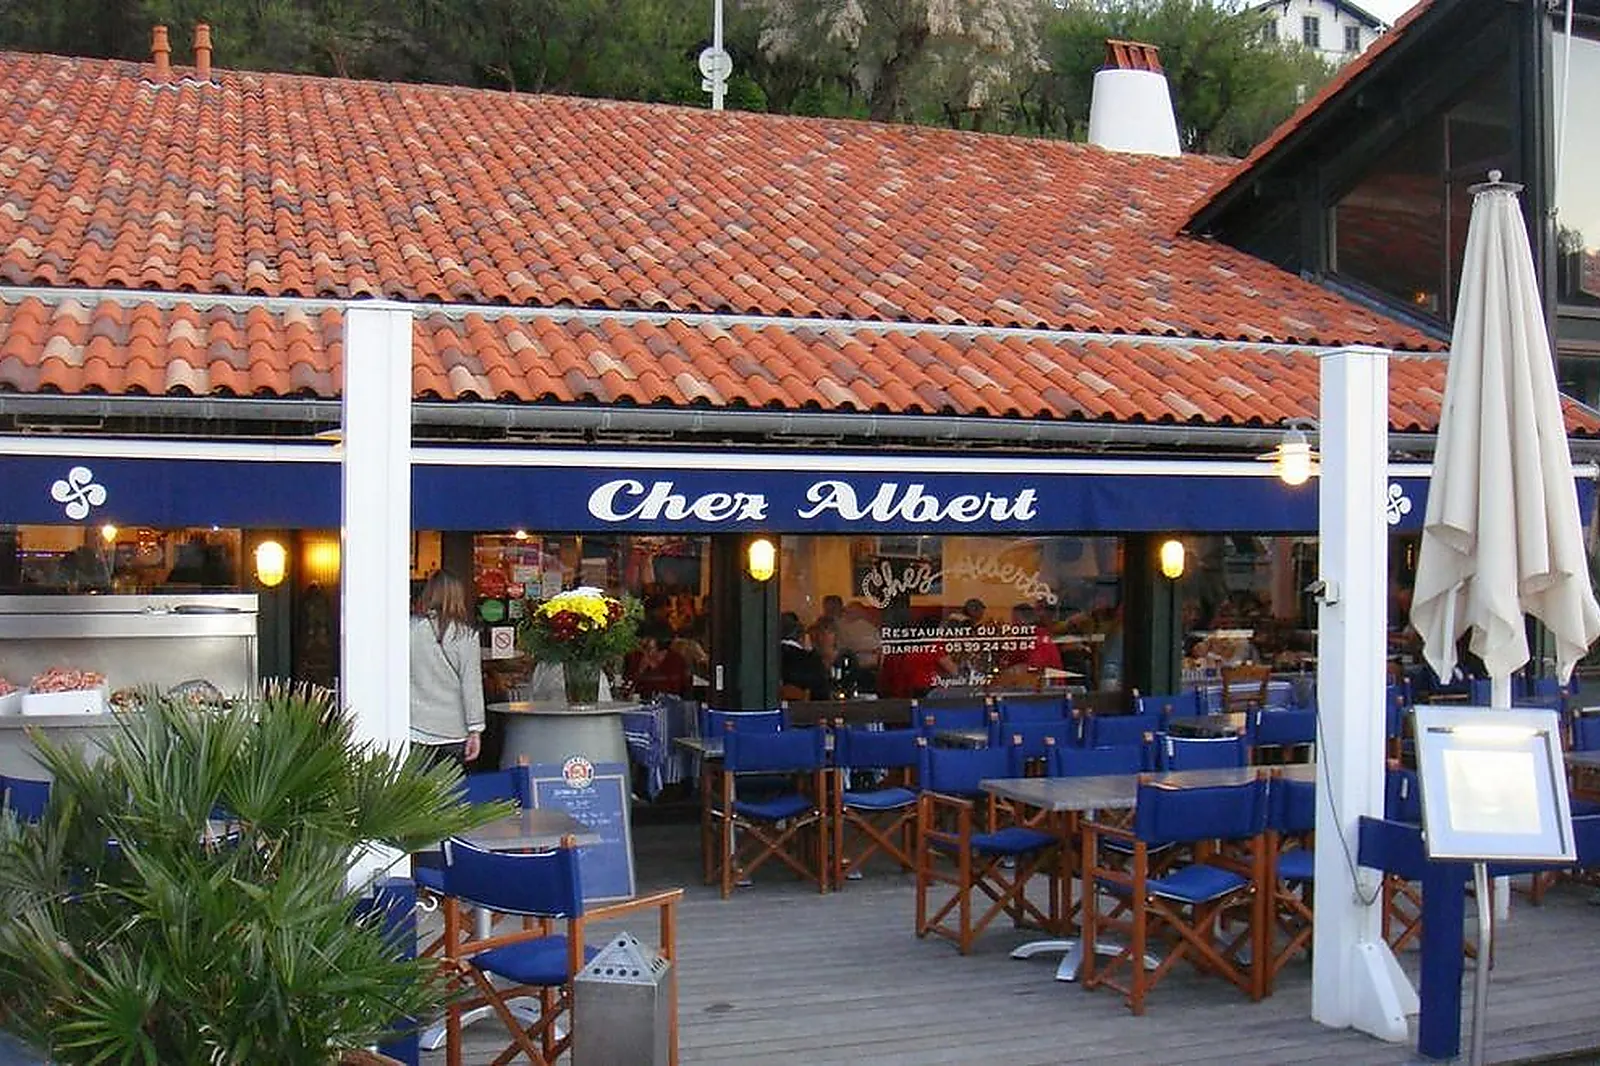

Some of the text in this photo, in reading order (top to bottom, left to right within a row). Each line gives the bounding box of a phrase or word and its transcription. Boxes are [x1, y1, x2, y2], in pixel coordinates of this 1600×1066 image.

[587, 478, 1039, 523] Chez Albert
[861, 559, 938, 608] Chez
